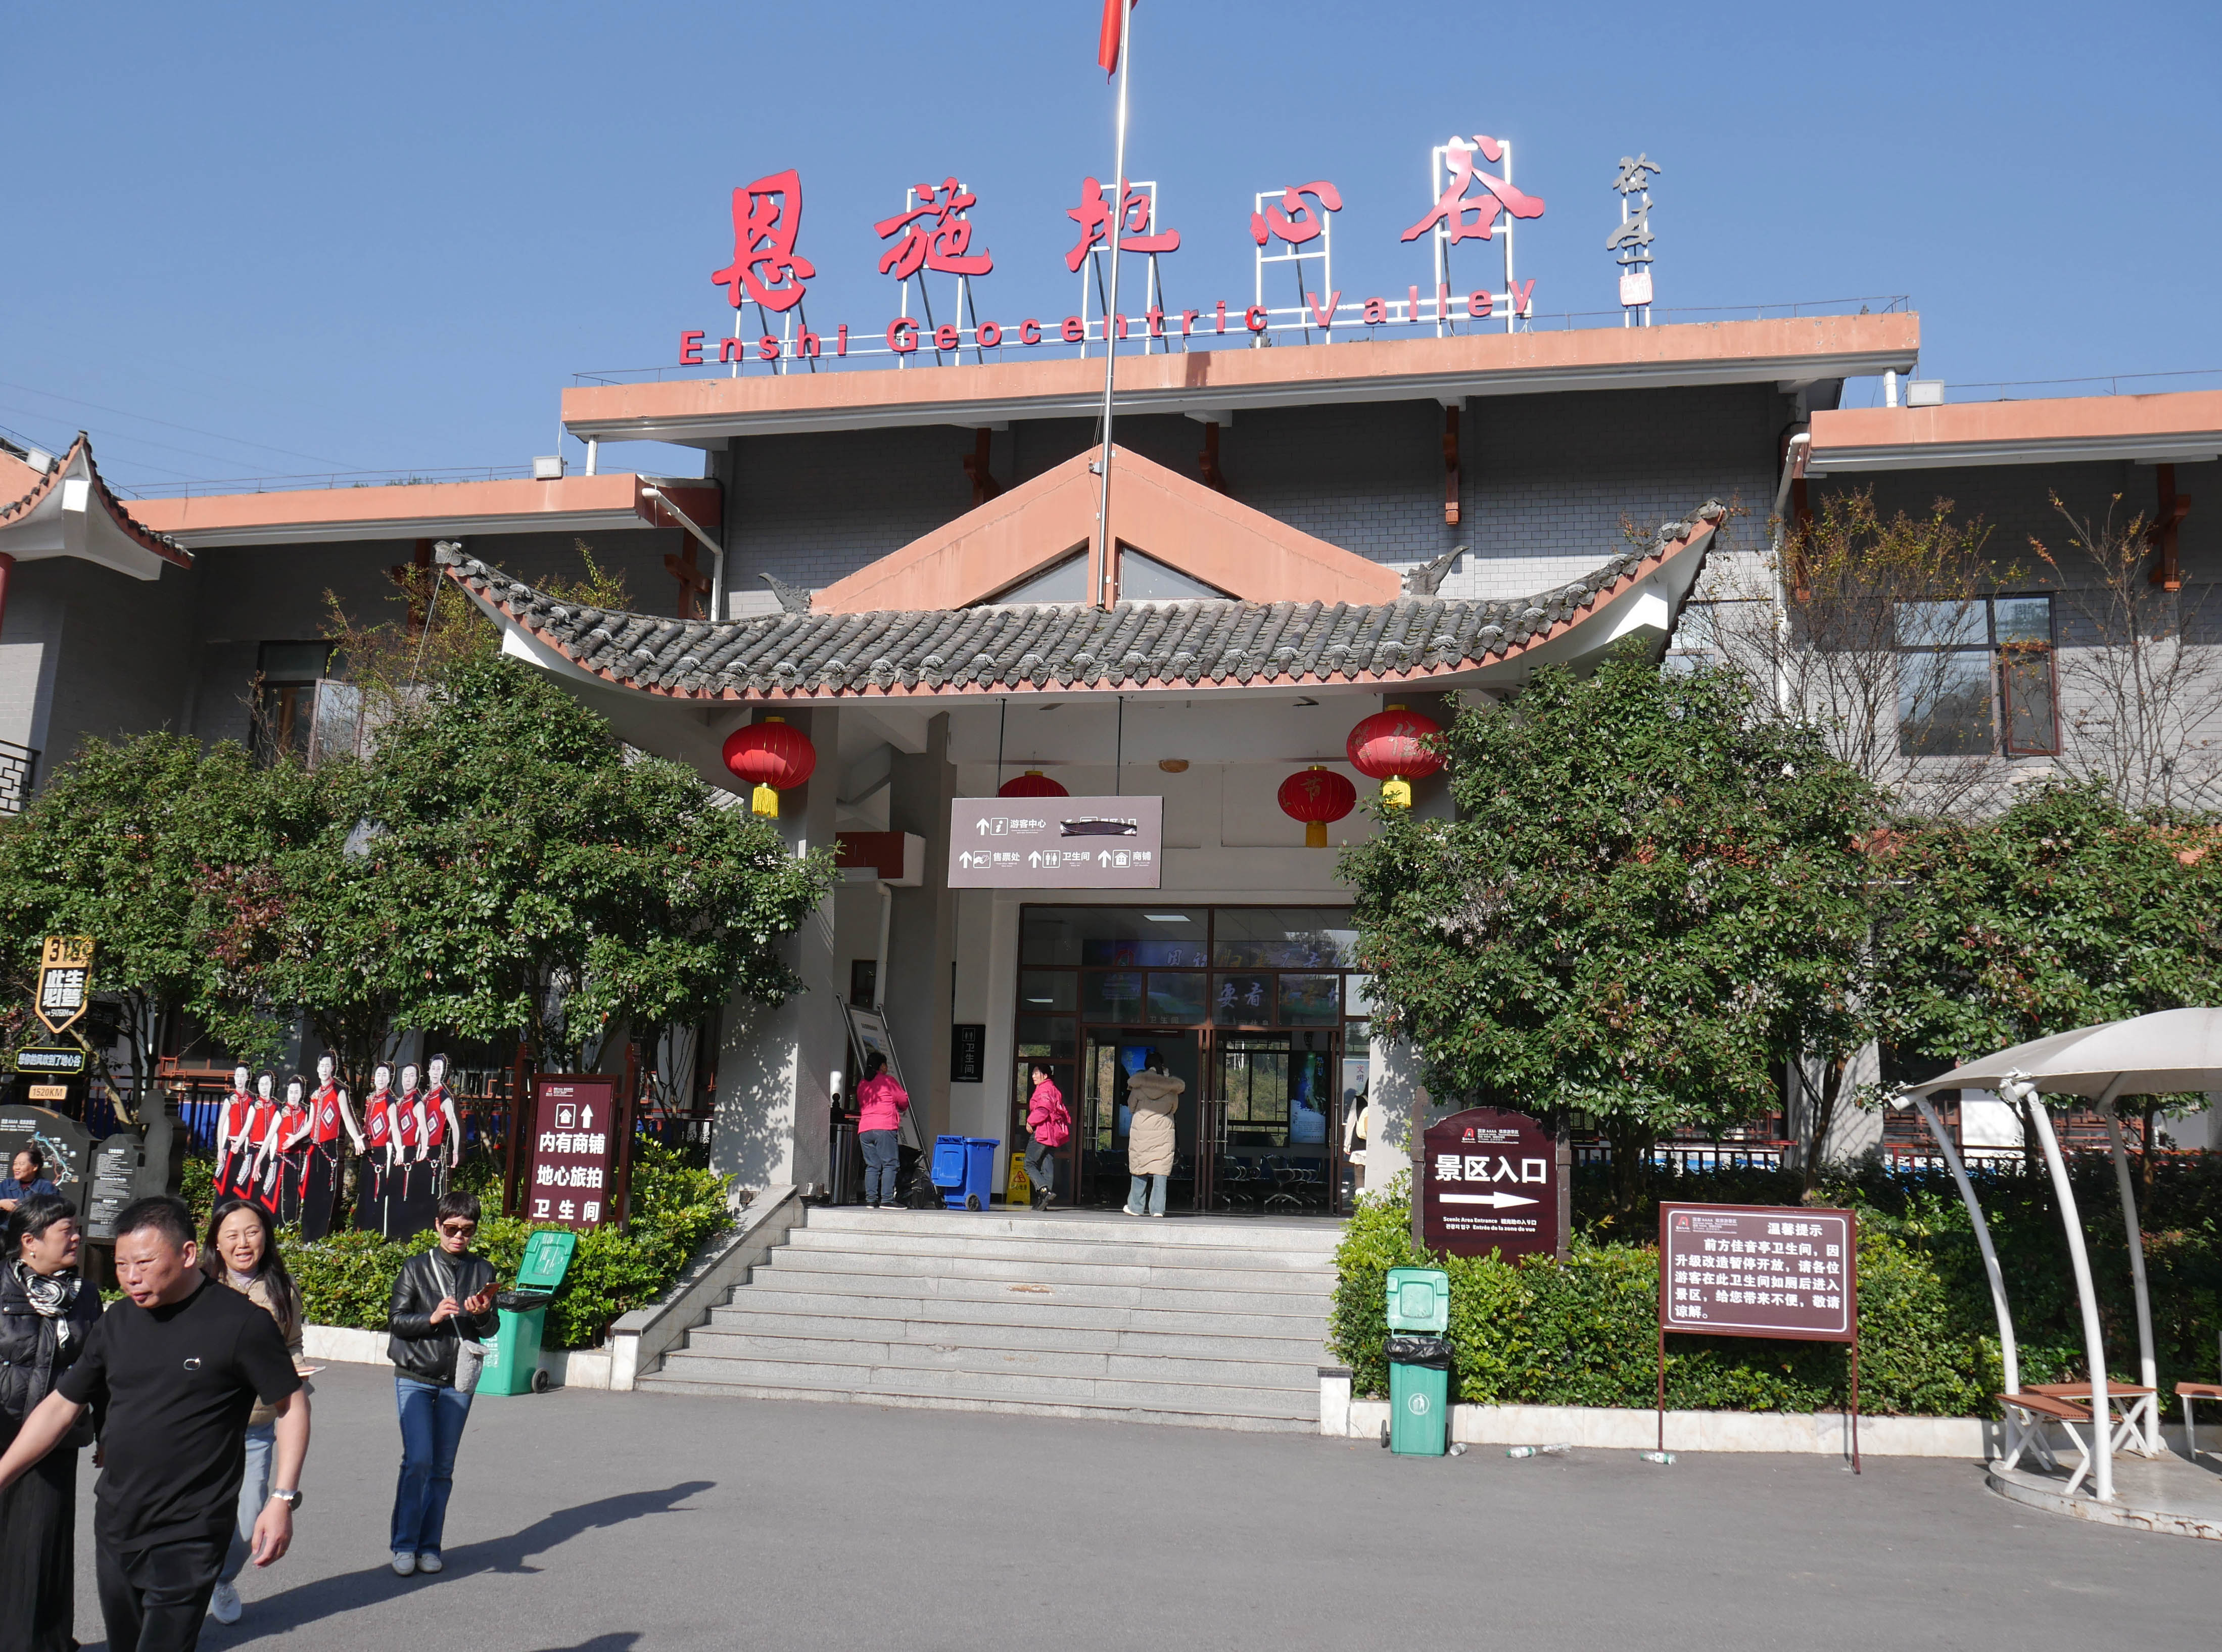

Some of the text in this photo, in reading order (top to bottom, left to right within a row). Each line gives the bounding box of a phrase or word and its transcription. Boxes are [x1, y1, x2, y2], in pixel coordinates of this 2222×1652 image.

[711, 134, 1544, 312] 恩施地心谷
[679, 278, 1536, 365] Enshi Geocentric Valley
[1010, 819, 1046, 828] 游客中心
[994, 852, 1020, 861] 售票处
[1062, 852, 1090, 861] 卫生间
[1133, 852, 1151, 861] 商铺
[45, 970, 84, 987] 此生
[42, 988, 81, 1007] 必驾
[965, 1044, 974, 1073] 卫生间
[539, 1131, 605, 1154] 内有商铺
[537, 1164, 603, 1189] 地心旅拍
[1435, 1155, 1546, 1184] 景区入口
[533, 1199, 600, 1221] 卫生间
[1768, 1222, 1823, 1237] 温馨提示
[1675, 1271, 1840, 1291] 游客在此卫生间如厕后进入
[1675, 1305, 1708, 1319] 谅解。
